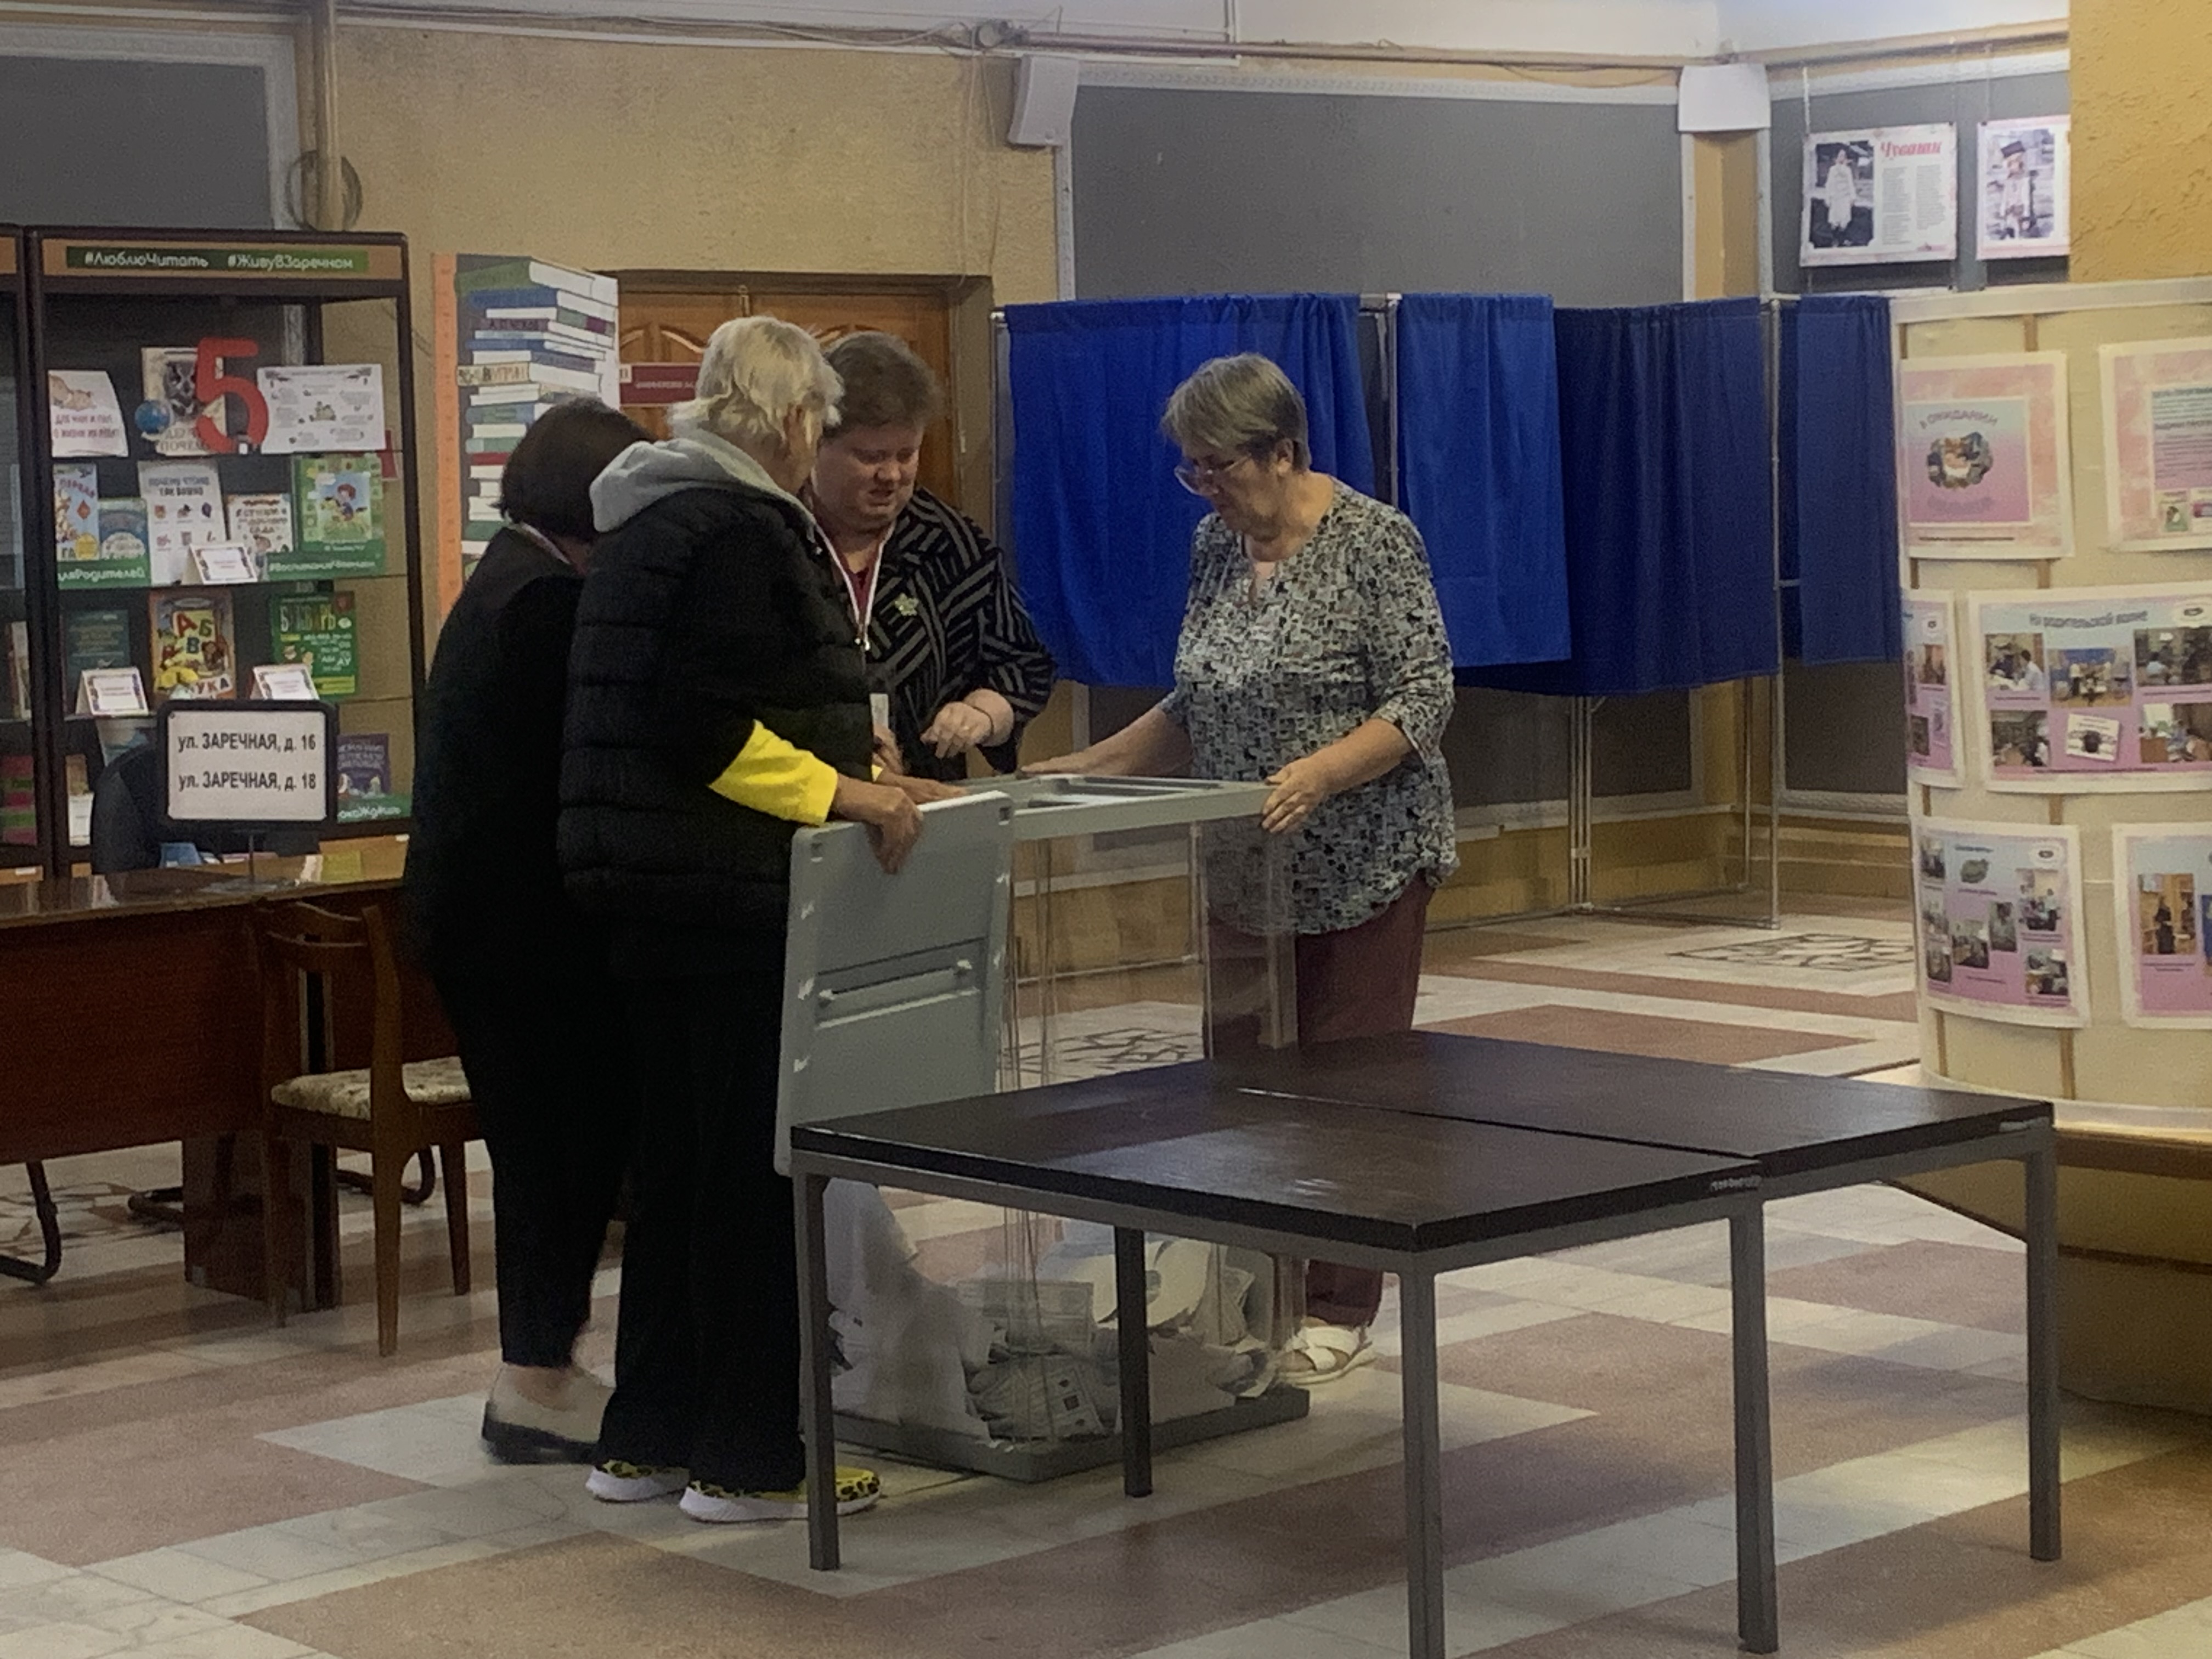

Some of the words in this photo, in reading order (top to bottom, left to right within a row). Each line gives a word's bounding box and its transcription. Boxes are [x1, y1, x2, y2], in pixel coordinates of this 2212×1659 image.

[84, 251, 208, 268] #ЛюблюЧитать
[197, 337, 269, 454] 5
[178, 736, 198, 753] ул.
[202, 732, 281, 753] ЗАРЕЧНАЯ,
[284, 737, 296, 753] д.
[301, 733, 316, 751] 16
[178, 775, 199, 792] ул.
[202, 771, 281, 792] ЗАРЕЧНАЯ,
[284, 776, 297, 792] д.
[301, 772, 316, 789] 18
